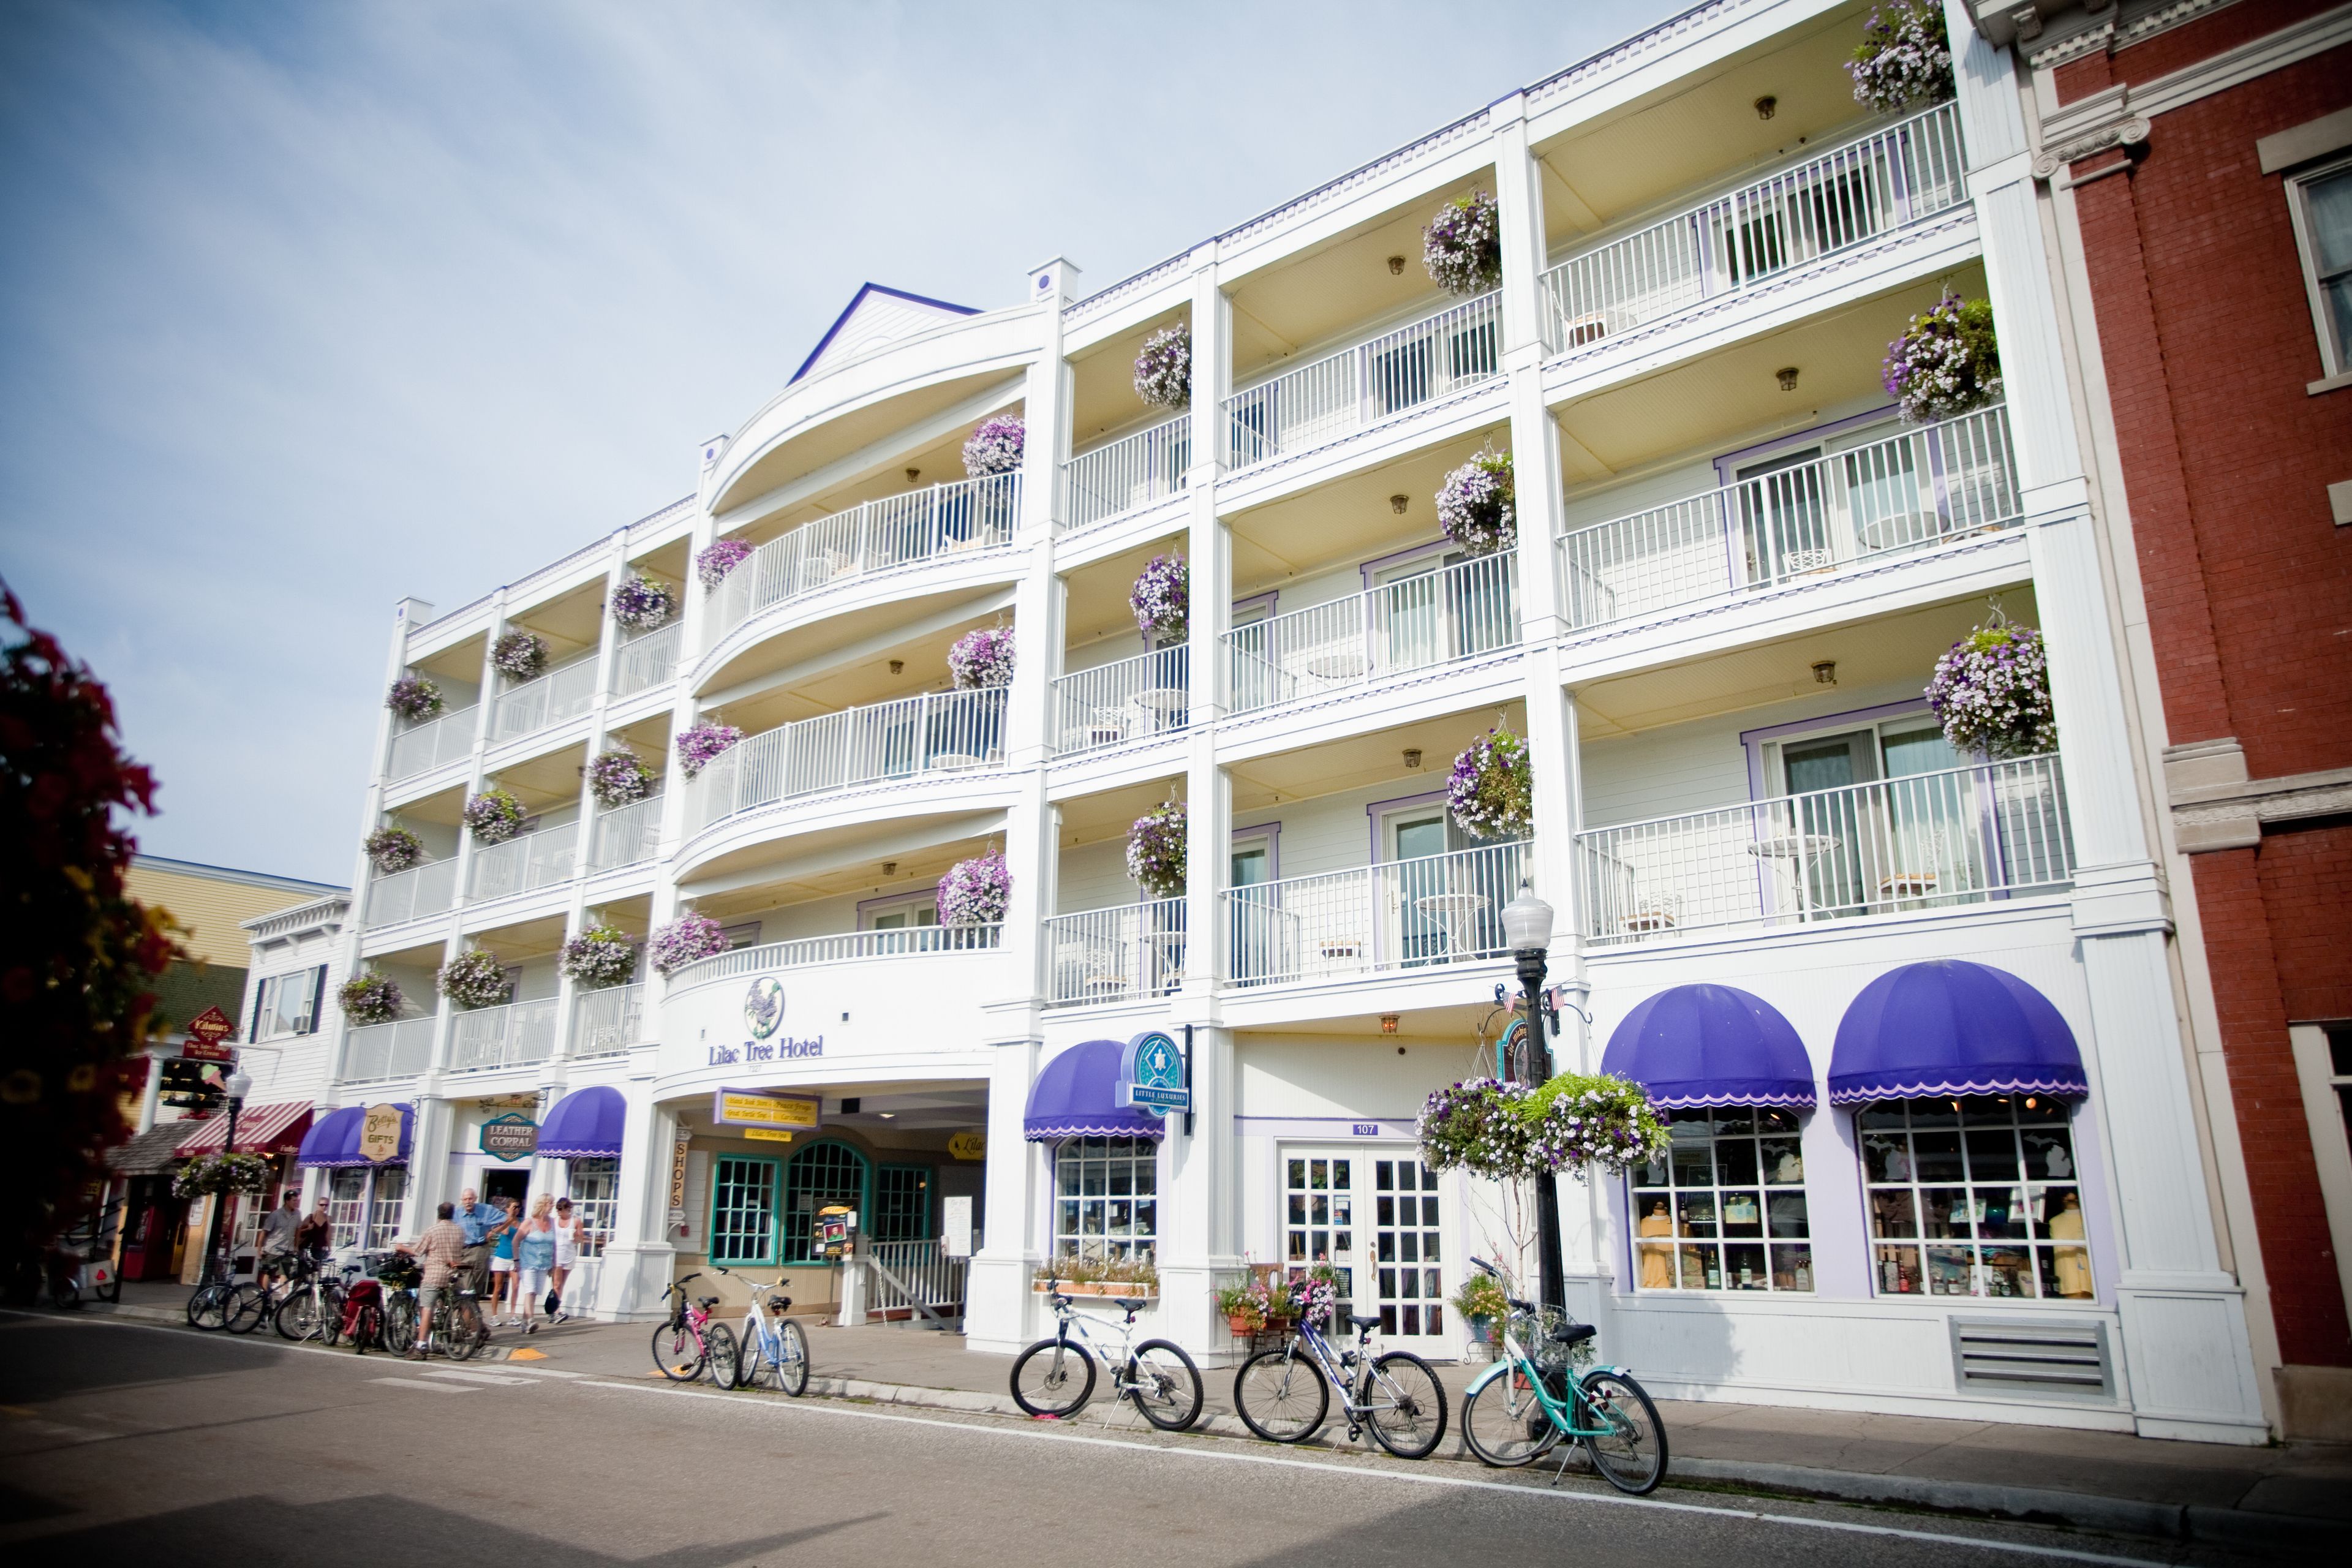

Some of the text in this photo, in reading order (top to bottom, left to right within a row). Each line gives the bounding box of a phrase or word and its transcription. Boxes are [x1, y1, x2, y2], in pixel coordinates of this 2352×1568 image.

[195, 1020, 228, 1032] Kilwins
[708, 1035, 824, 1065] Lilac Tree Hotel
[1157, 1092, 1186, 1101] LUXURIES
[368, 1112, 398, 1132] Betty's
[490, 1125, 533, 1137] LEATHER
[1357, 1125, 1374, 1134] 107
[368, 1134, 394, 1144] GIFTS
[491, 1137, 532, 1147] CORRAL
[280, 1144, 299, 1153] Fudge
[963, 1137, 985, 1155] Lilac
[672, 1144, 685, 1206] SHOPS
